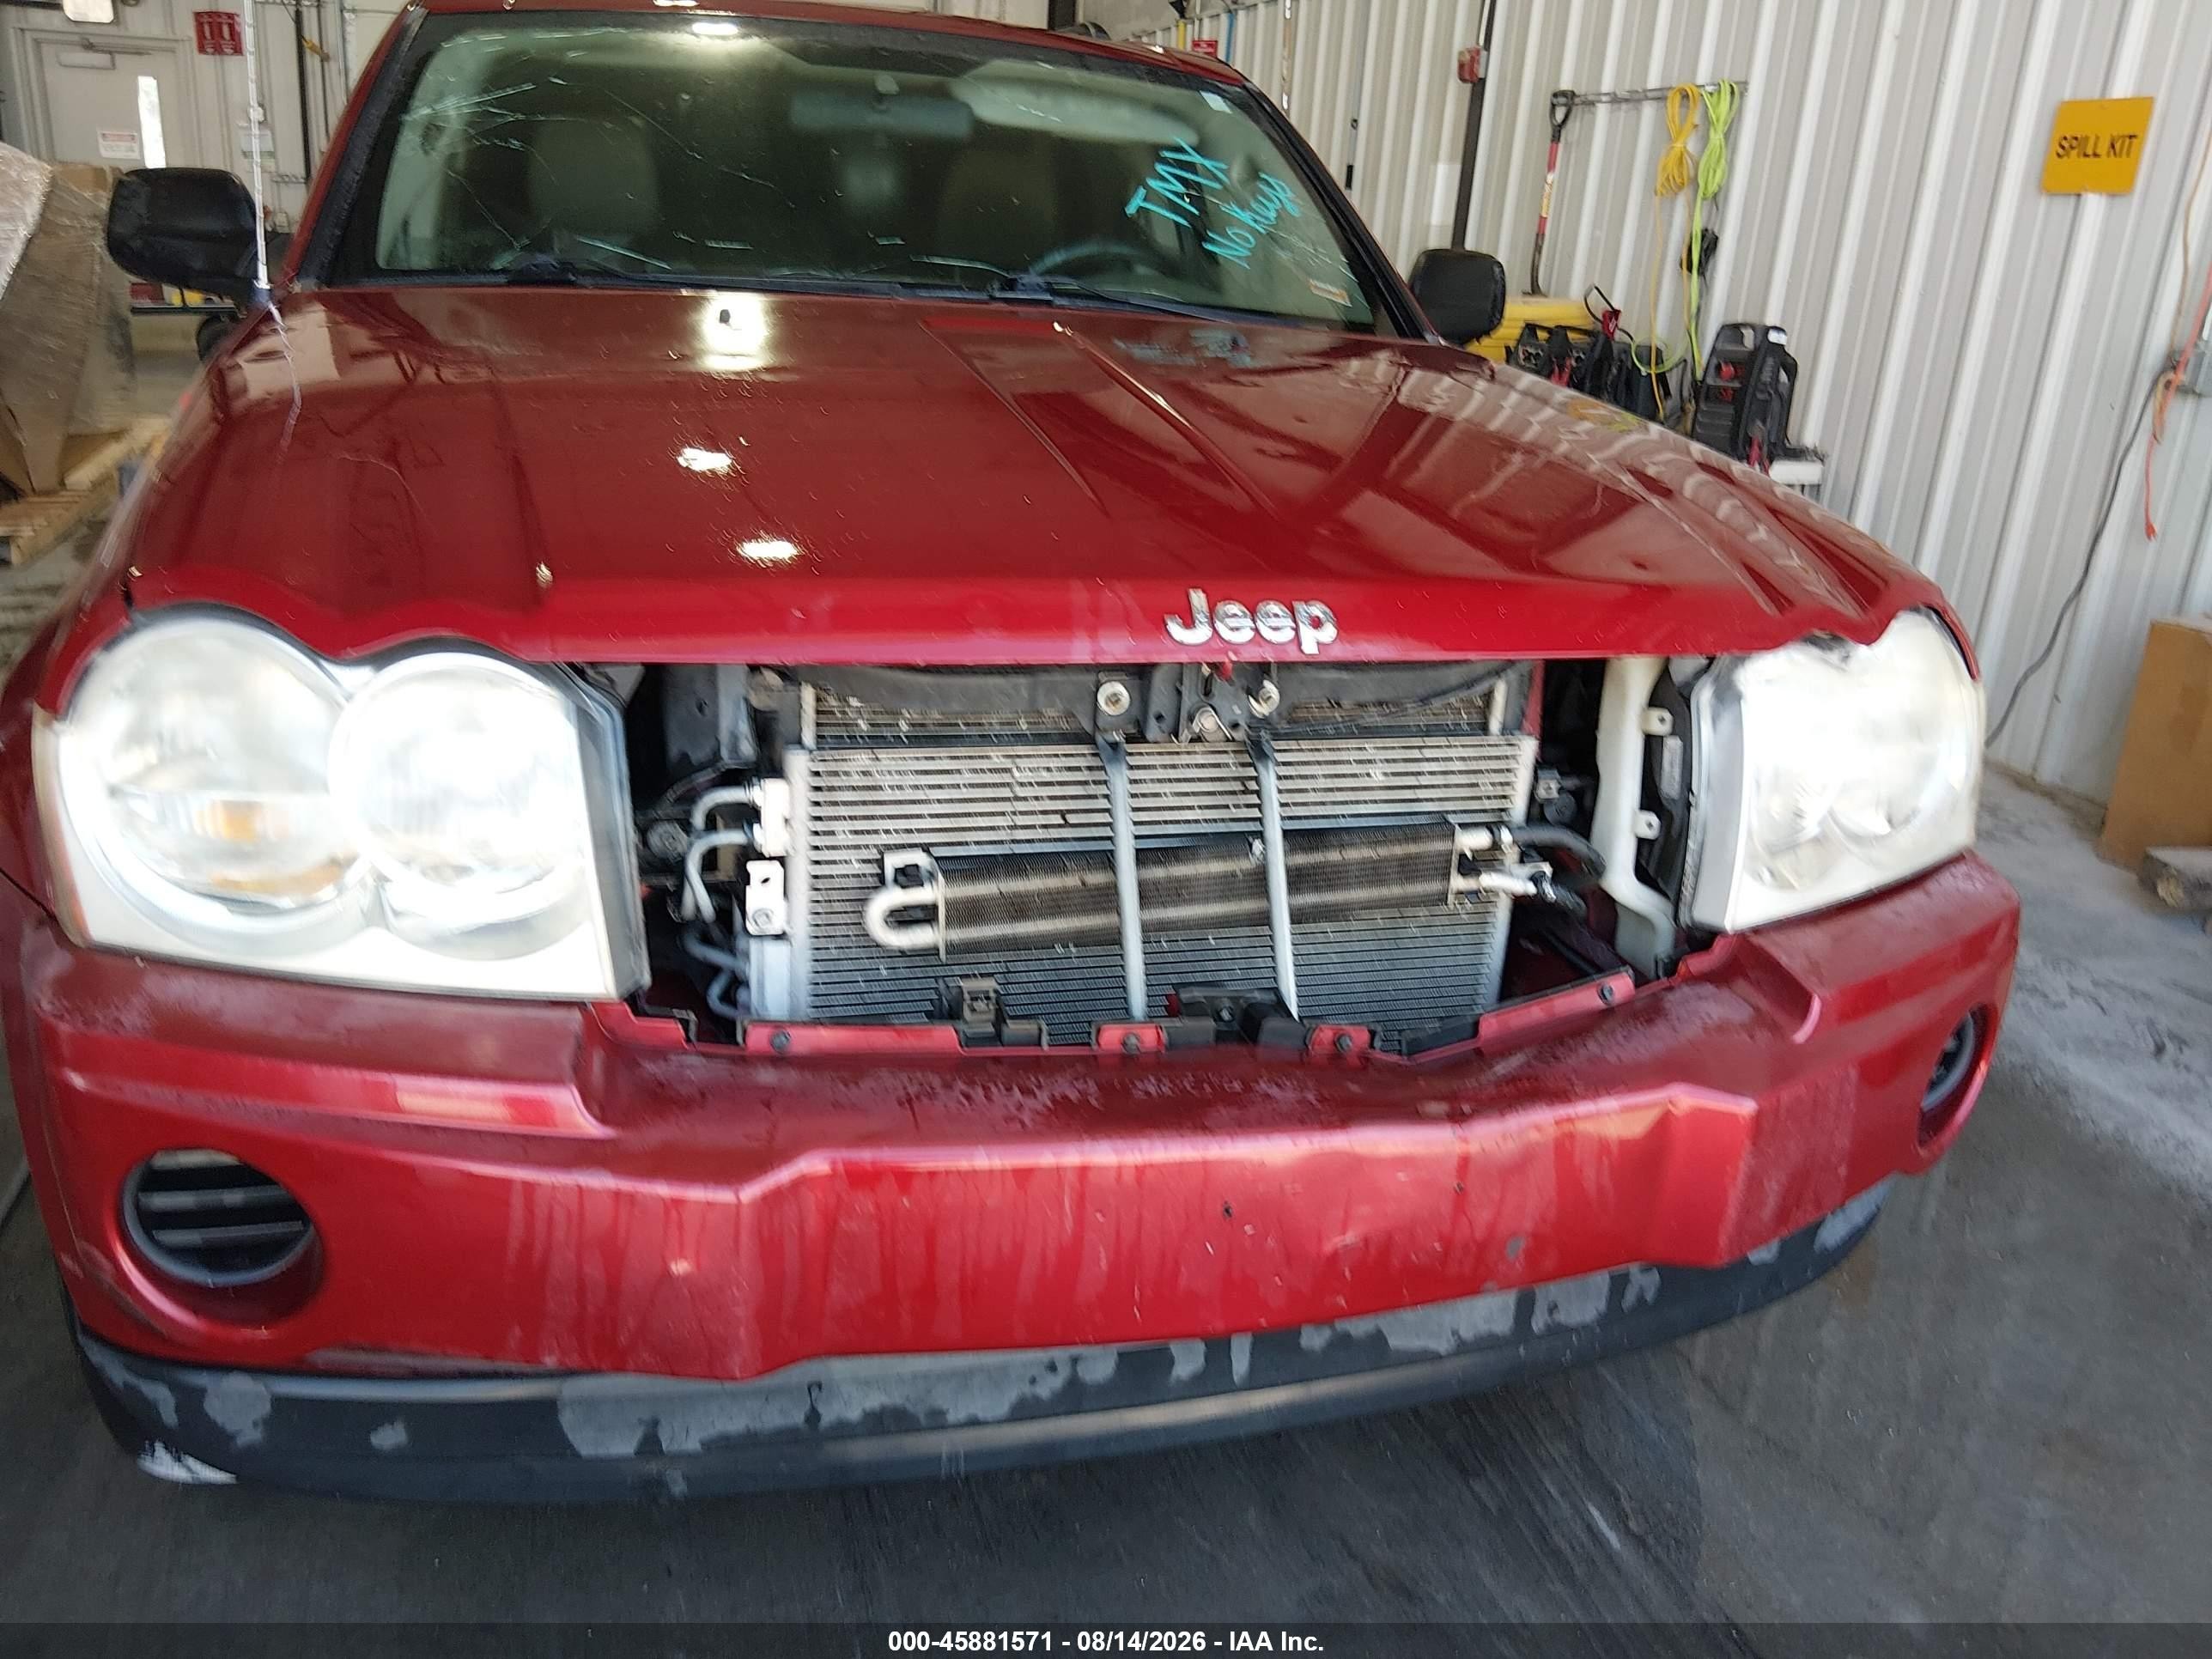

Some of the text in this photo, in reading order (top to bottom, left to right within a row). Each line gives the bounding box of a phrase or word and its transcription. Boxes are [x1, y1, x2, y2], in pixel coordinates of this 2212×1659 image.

[2056, 134, 2136, 159] SPILL KIT
[1164, 587, 1338, 654] Jeep
